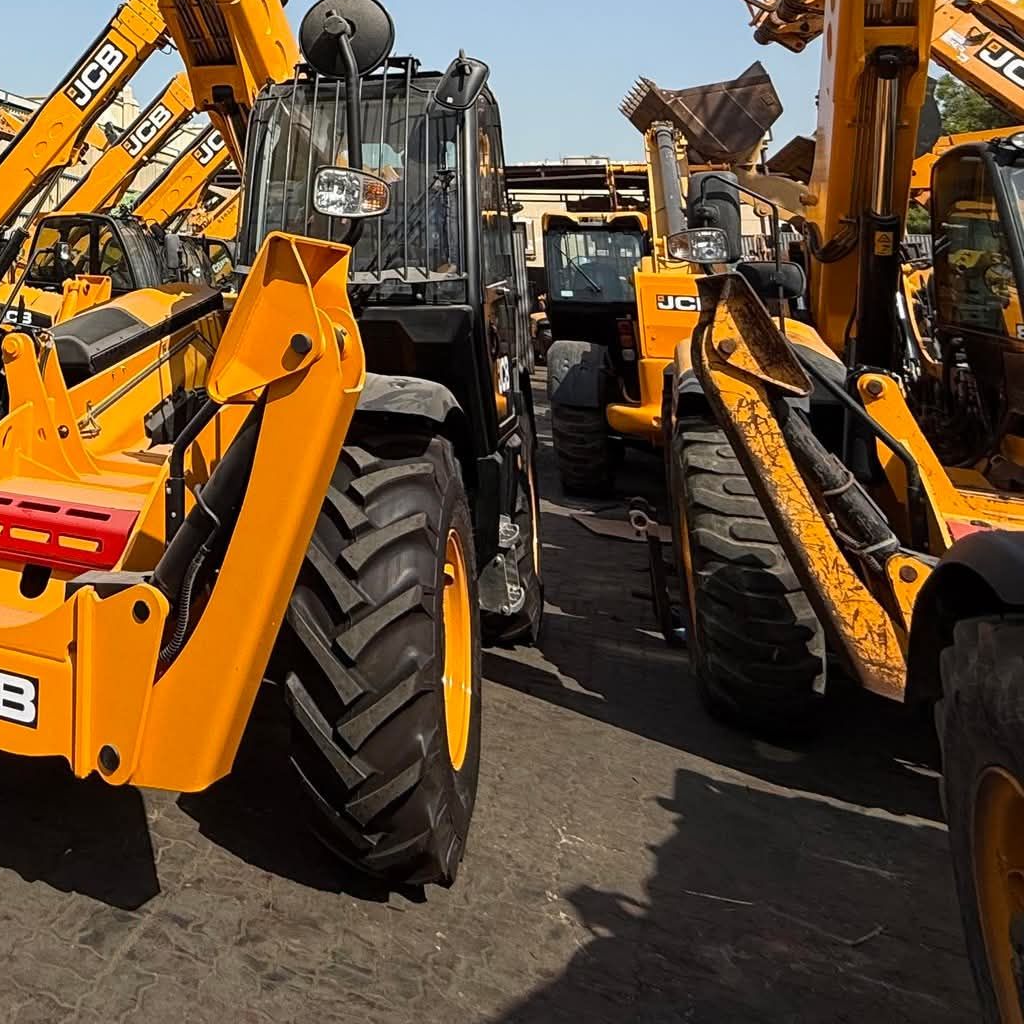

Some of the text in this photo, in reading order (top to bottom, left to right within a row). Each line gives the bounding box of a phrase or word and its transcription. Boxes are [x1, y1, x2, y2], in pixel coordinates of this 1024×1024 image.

[74, 44, 123, 106] JCB
[979, 48, 1024, 87] JC
[127, 105, 172, 156] JCB
[198, 129, 225, 164] JC
[3, 310, 32, 324] CB
